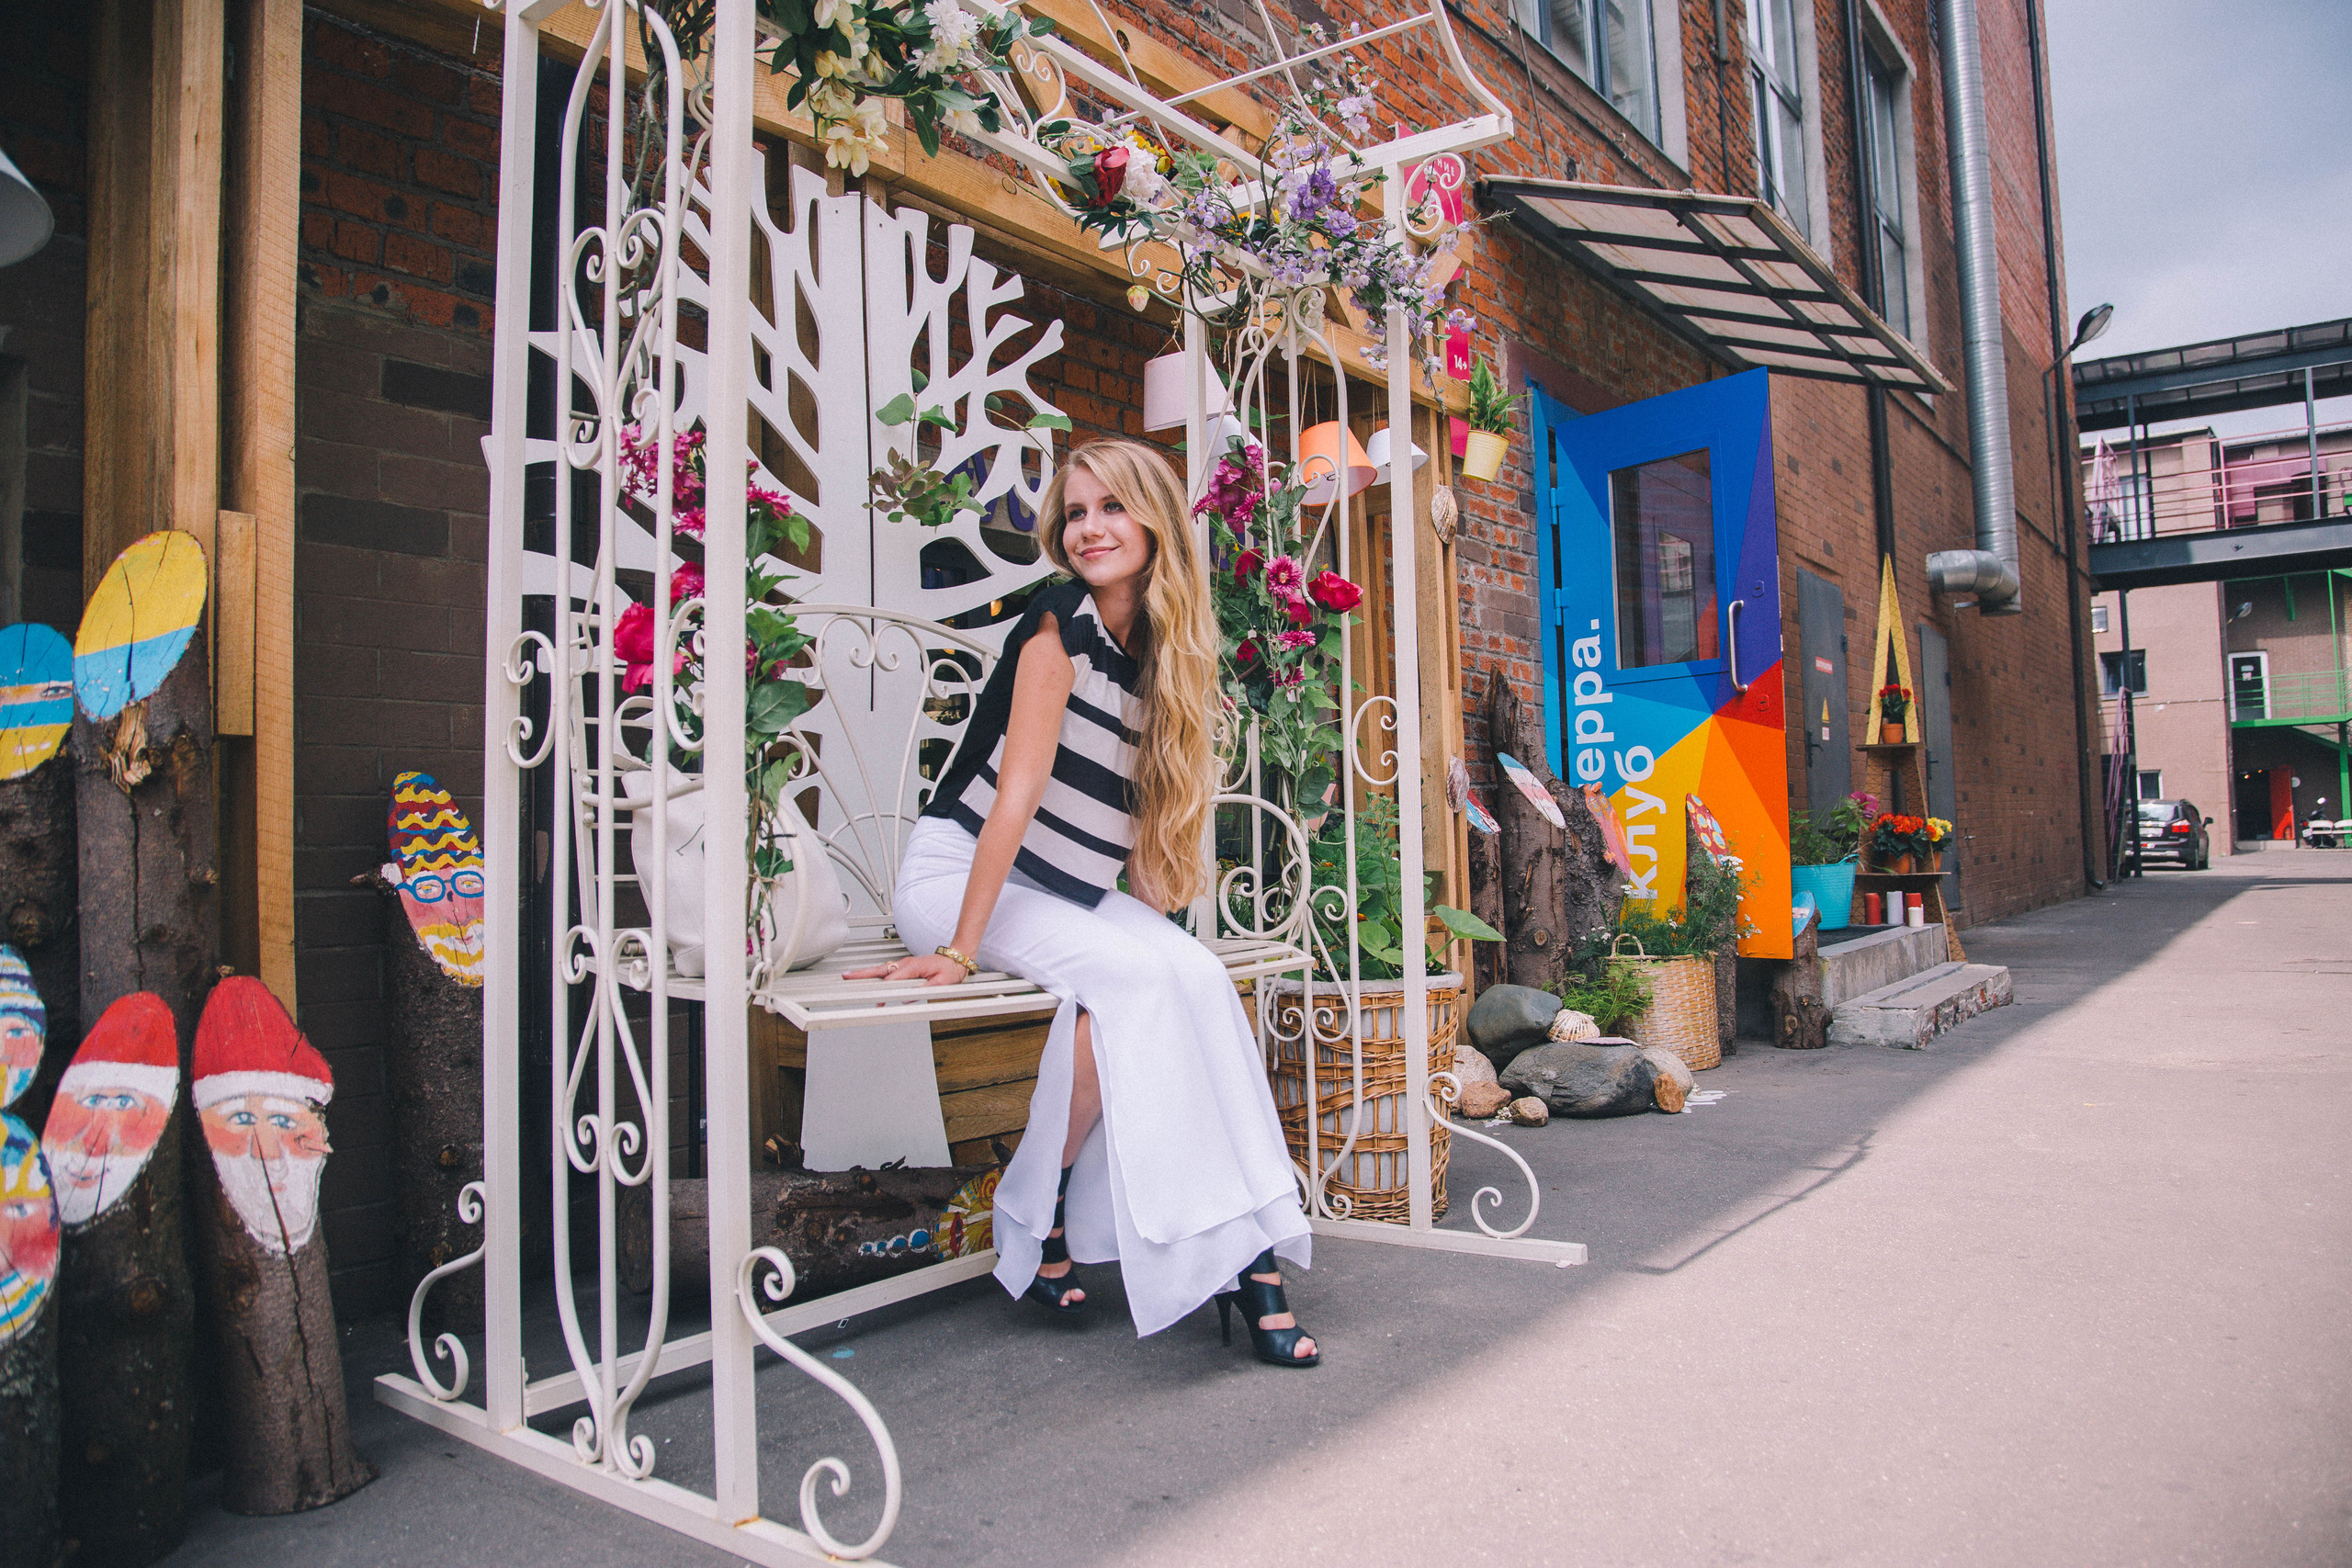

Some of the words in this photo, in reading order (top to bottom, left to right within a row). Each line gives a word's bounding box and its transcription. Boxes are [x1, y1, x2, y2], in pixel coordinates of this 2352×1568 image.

[1433, 157, 1456, 177] НИЕ
[1572, 618, 1614, 788] ерра.
[1613, 745, 1667, 899] клуб
